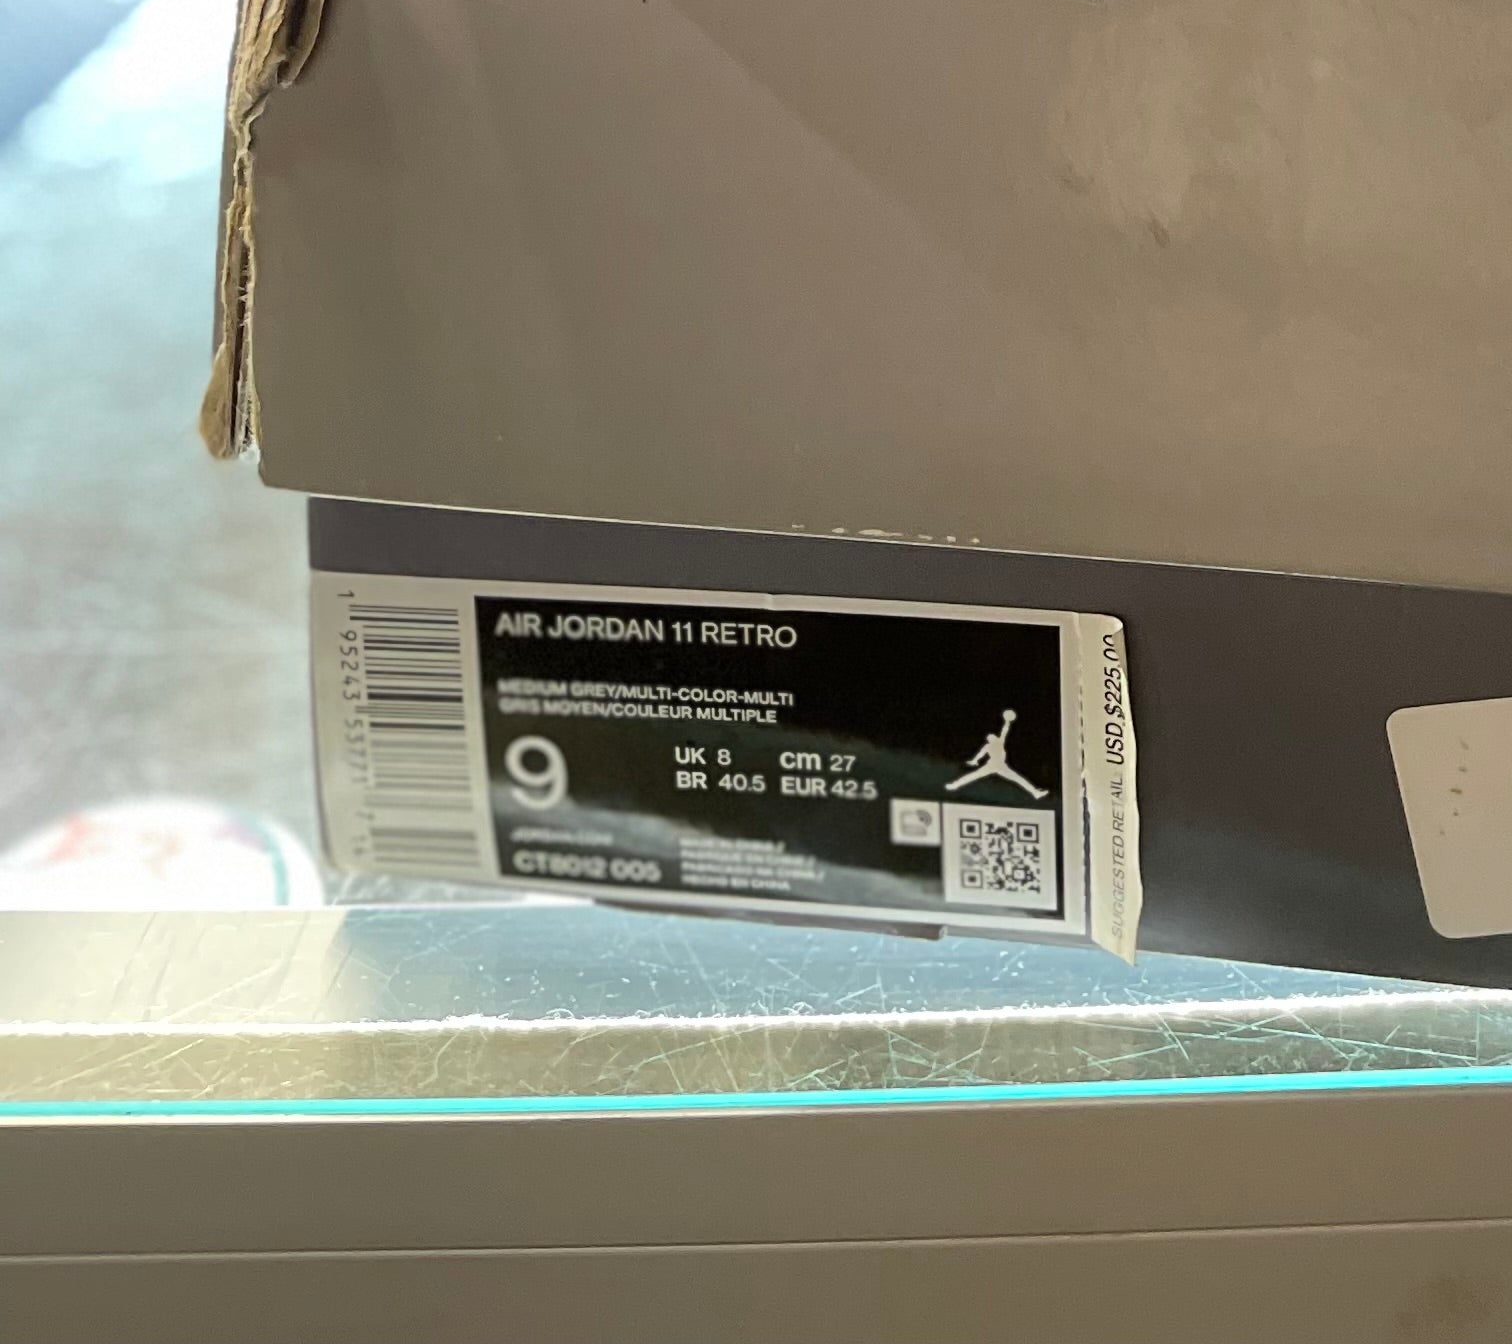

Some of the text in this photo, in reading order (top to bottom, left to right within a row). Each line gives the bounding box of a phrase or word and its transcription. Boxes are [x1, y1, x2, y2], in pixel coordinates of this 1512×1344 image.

[337, 590, 356, 598] 1
[495, 613, 797, 648] AIR JORDAN 11 RETRO
[339, 630, 362, 701] 95243
[497, 678, 794, 706] MEDIUM GREY/MULTI-COLOR-MULTI
[543, 698, 693, 720] MOYEN/COULEUR
[696, 709, 778, 724] MULTIPLE
[675, 747, 856, 772] UK 8 cm 27
[1104, 722, 1125, 765] USD
[504, 735, 569, 810] 9
[676, 771, 878, 800] BR 40.5 EUR 42.5
[1110, 835, 1126, 939] SUGGESTED
